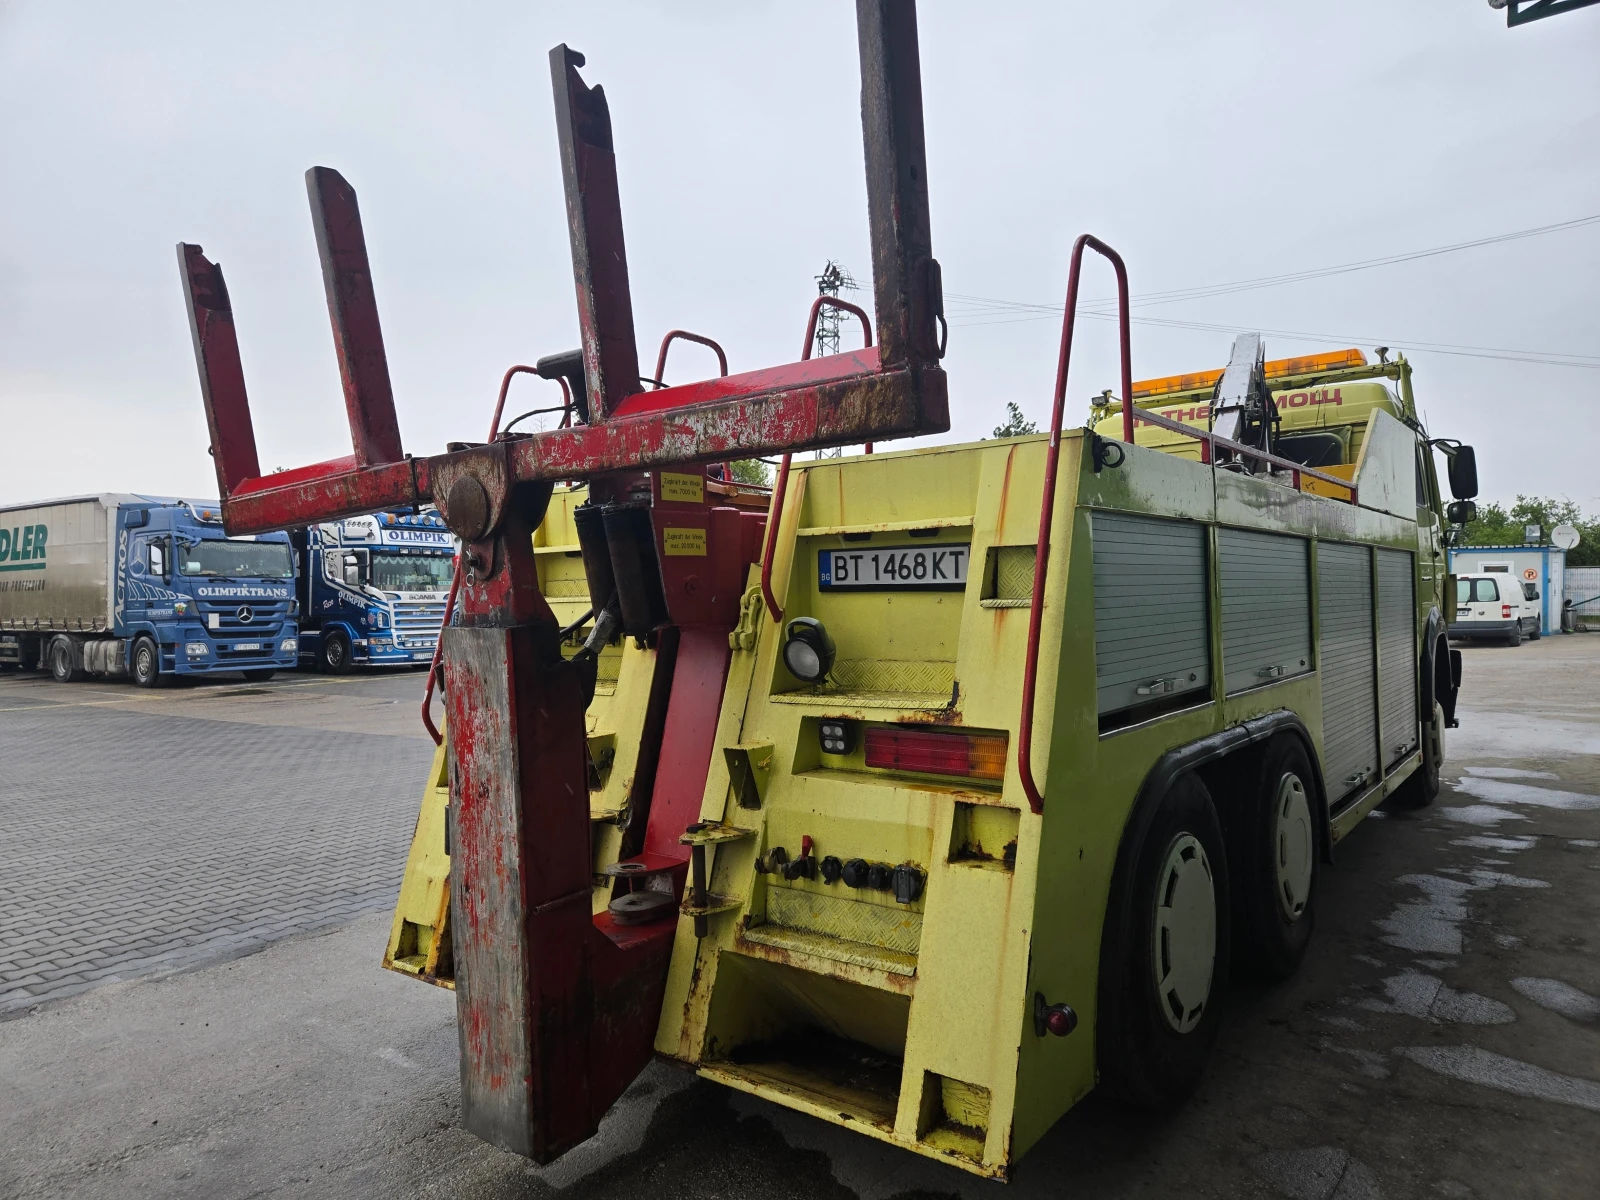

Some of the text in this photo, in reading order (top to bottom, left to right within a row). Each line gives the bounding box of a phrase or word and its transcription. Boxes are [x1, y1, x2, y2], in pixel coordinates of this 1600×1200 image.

[0, 524, 48, 563] DLER
[388, 530, 447, 543] OLIMPIK
[834, 550, 965, 582] BT 1468 KT
[115, 529, 128, 628] ACTROS
[821, 573, 831, 581] BG
[197, 587, 288, 597] OLIMPIKTRANS
[338, 591, 366, 610] OLIMPIK
